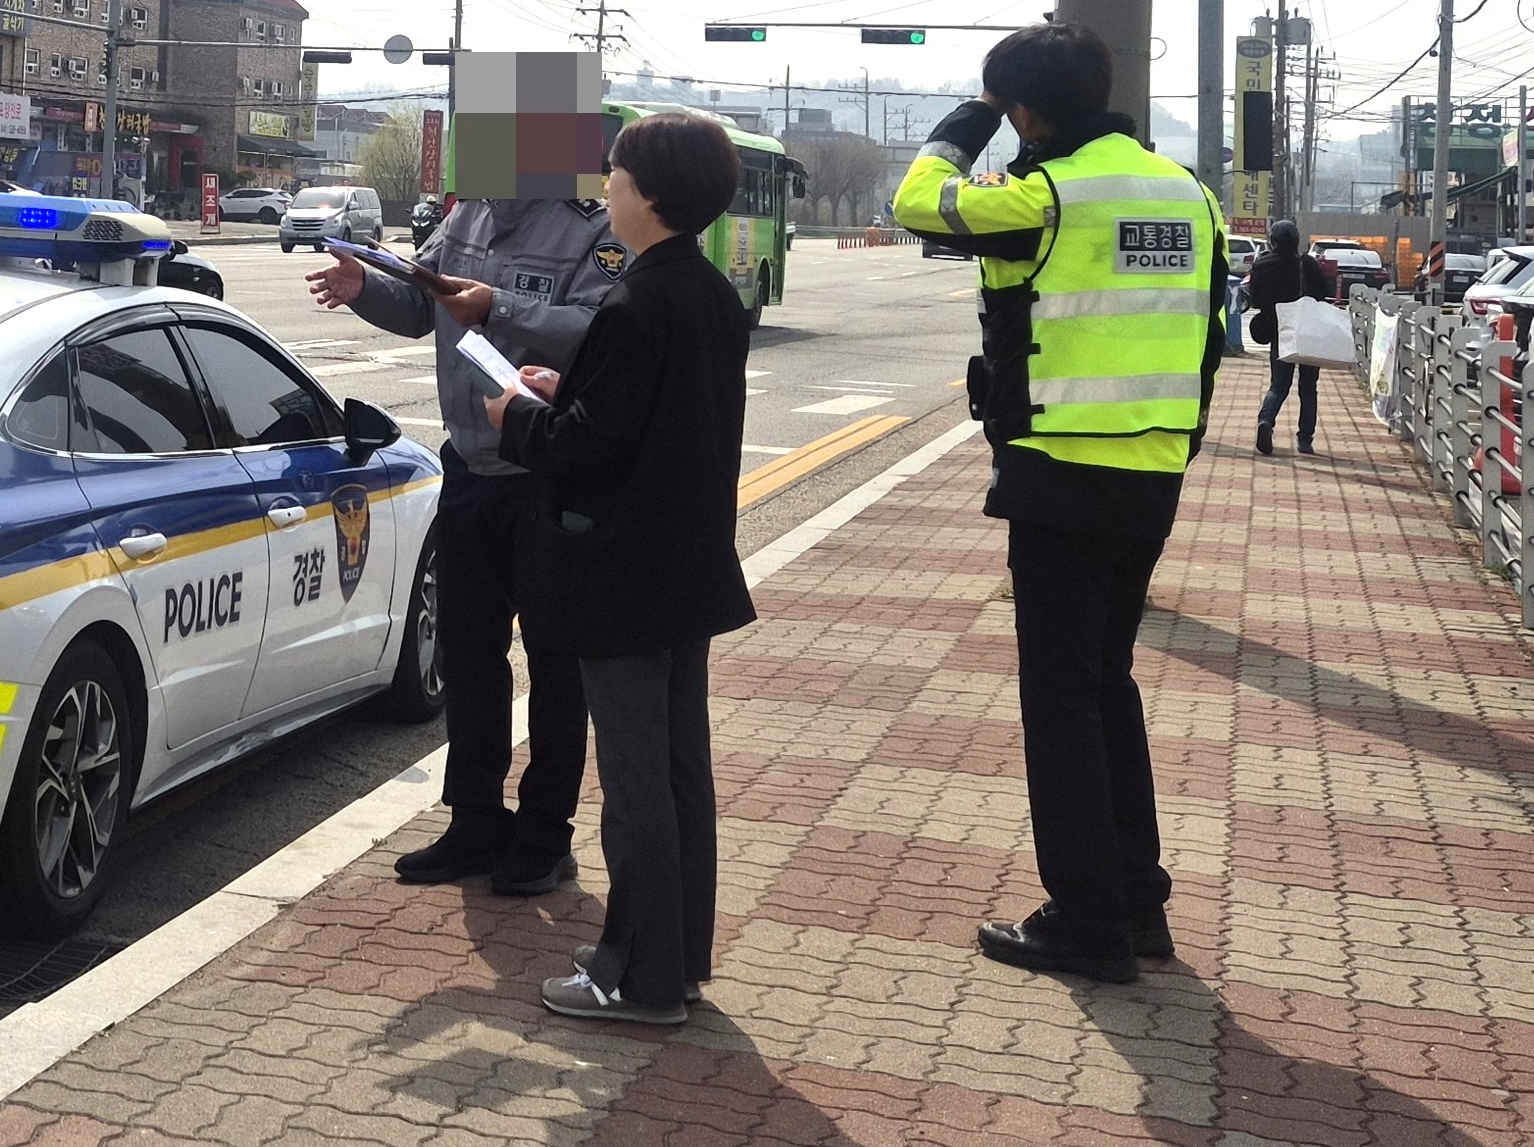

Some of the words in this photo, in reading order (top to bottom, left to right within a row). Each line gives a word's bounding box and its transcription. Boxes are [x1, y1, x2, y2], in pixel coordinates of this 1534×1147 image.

[205, 176, 216, 226] 새조개
[1124, 225, 1189, 248] 교통경찰
[1126, 254, 1188, 267] POLICE
[518, 275, 550, 292] 경찰
[292, 547, 326, 608] 경찰
[165, 572, 243, 643] POLICE
